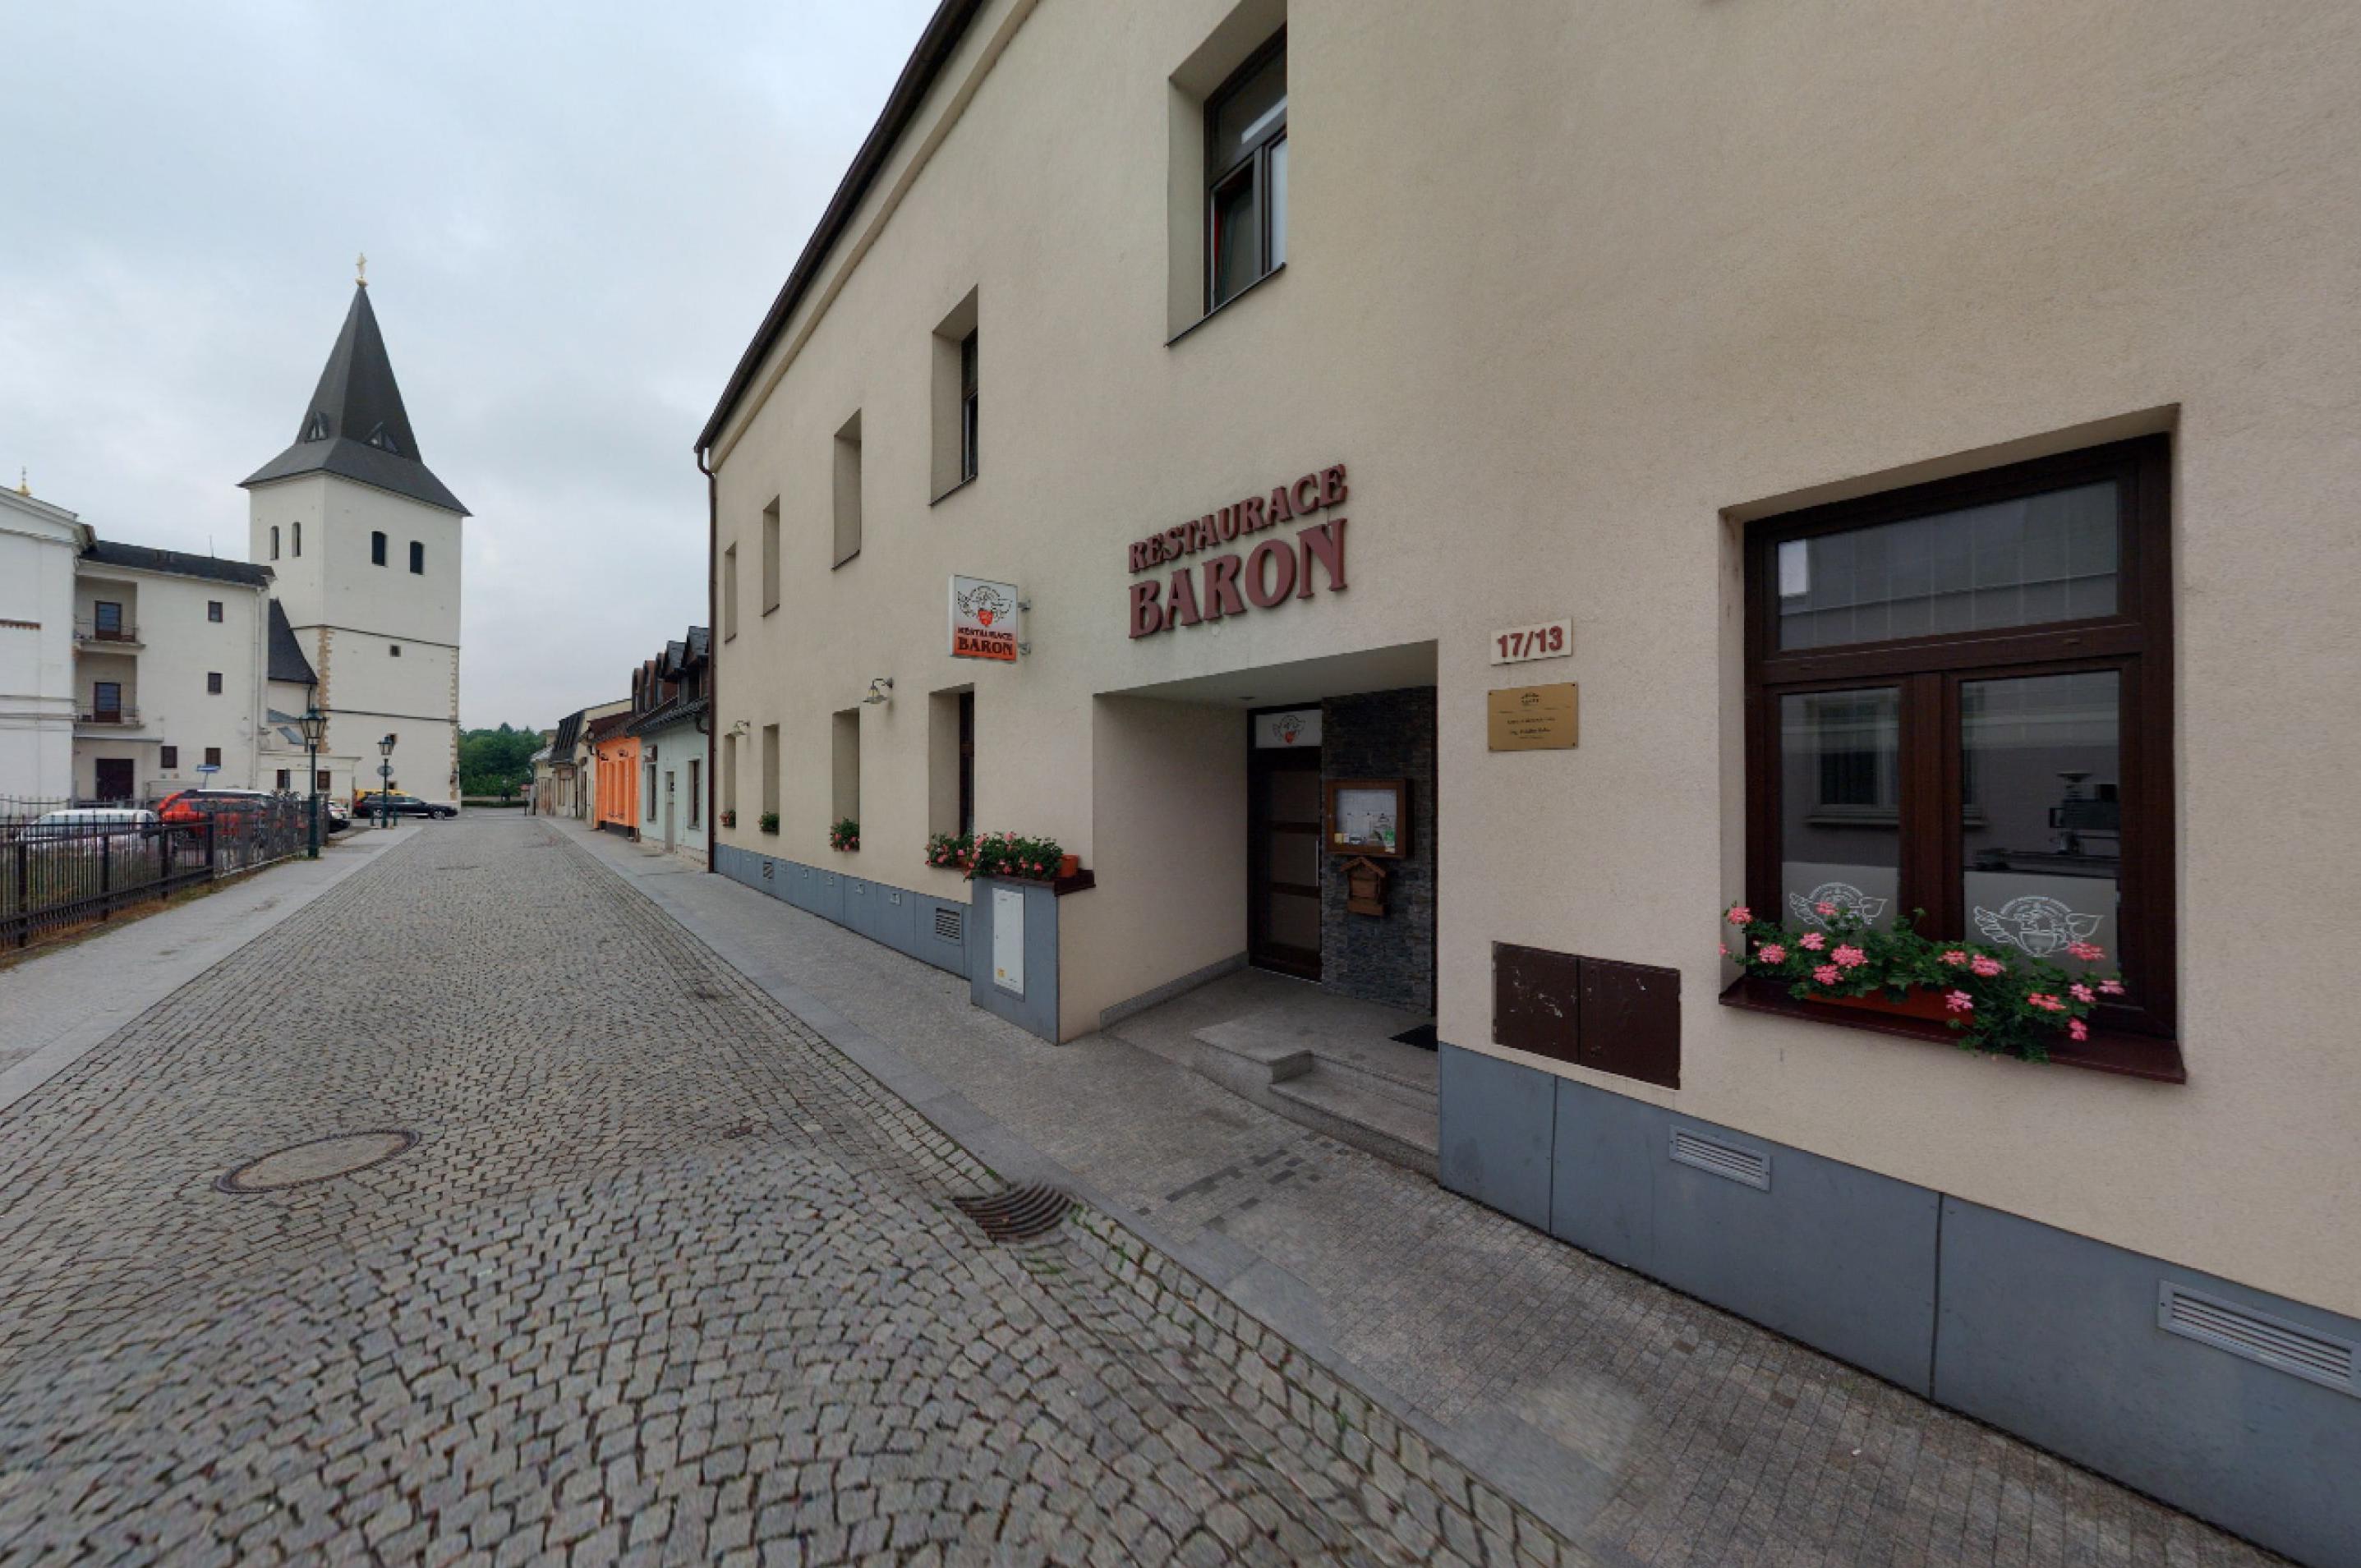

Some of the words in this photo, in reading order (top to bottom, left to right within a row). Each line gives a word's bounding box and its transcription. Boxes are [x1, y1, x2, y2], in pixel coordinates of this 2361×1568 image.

[1129, 464, 1348, 574] RESTAURACE
[1129, 518, 1348, 639] BARON
[957, 627, 1013, 641] RESTAURACE
[958, 636, 1013, 655] BARON
[1497, 626, 1562, 658] 17/13
